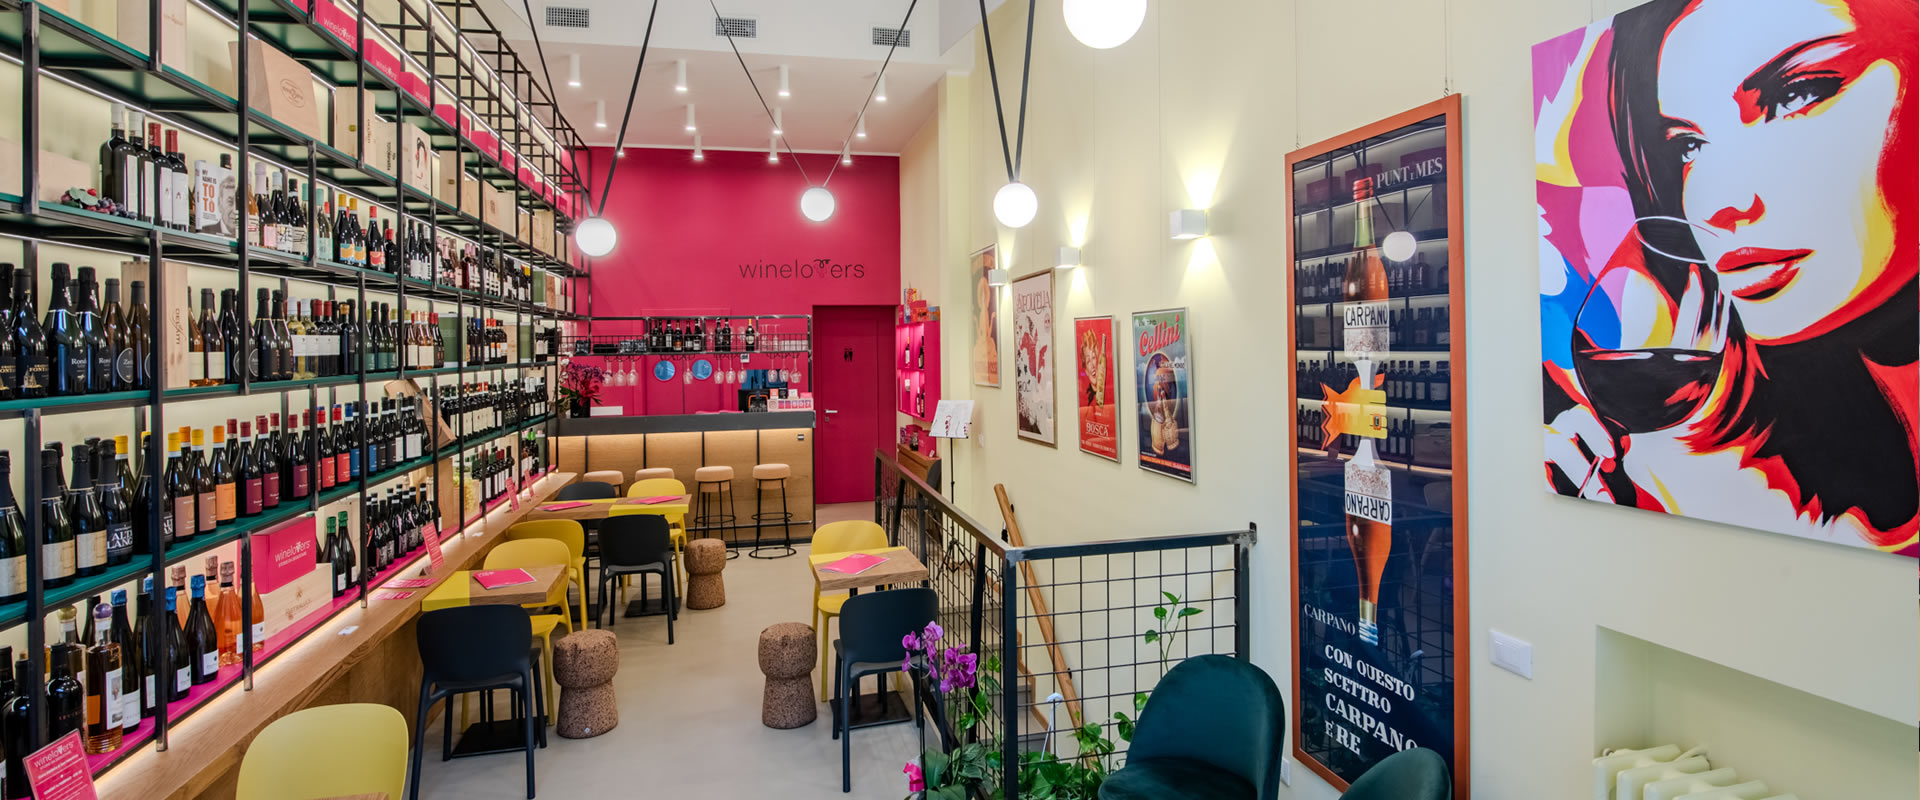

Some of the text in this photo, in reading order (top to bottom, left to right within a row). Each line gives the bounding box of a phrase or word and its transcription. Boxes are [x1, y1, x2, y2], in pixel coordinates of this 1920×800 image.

[1376, 166, 1410, 189] PUNT
[1415, 157, 1444, 178] MES
[203, 184, 215, 198] TO
[203, 198, 215, 213] TO
[739, 258, 865, 279] winelovers
[1345, 304, 1389, 326] CARPANO
[1139, 313, 1181, 357] Cellini
[1086, 422, 1109, 437] BOSCA
[1345, 493, 1390, 522] CARPANO
[275, 540, 311, 562] winelovers
[1304, 603, 1356, 636] CARPANO
[1324, 643, 1415, 701] CON QUESTO
[1324, 667, 1392, 714] SCETTRO
[1335, 721, 1361, 756] RE
[34, 741, 74, 768] winelovers
